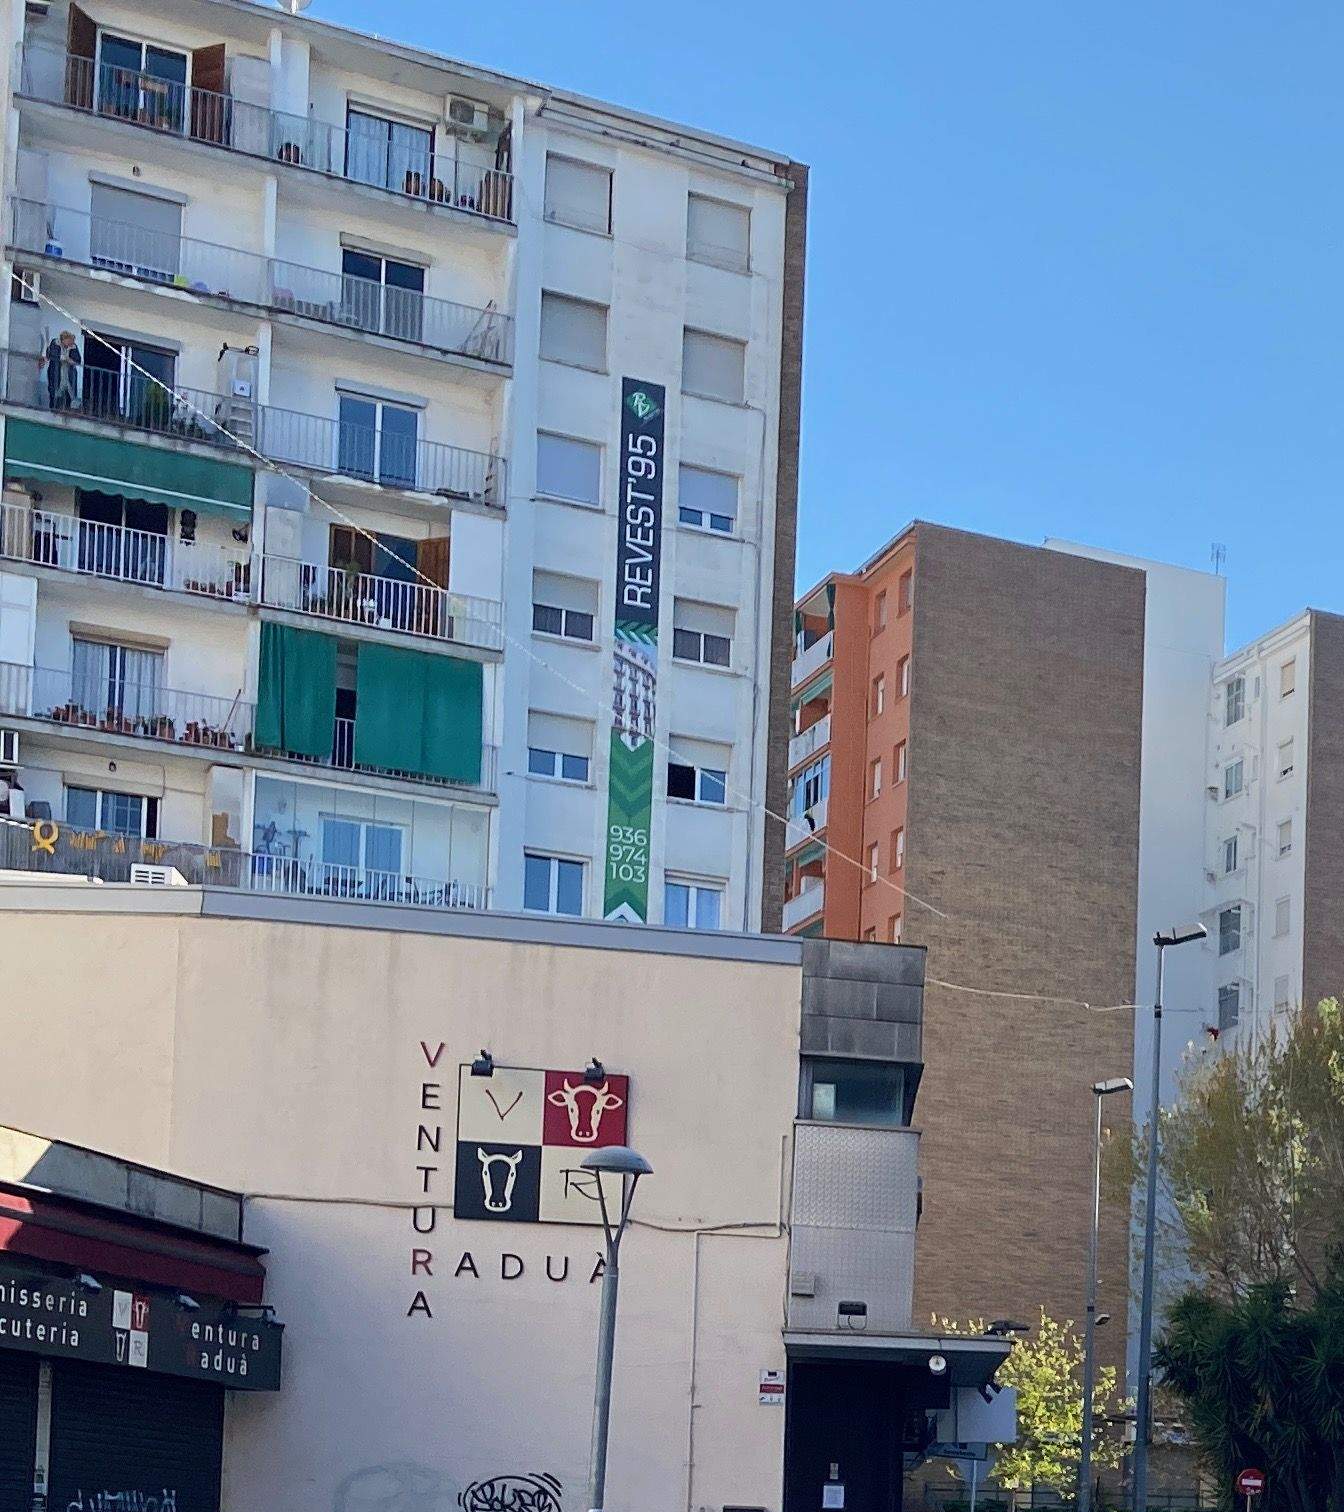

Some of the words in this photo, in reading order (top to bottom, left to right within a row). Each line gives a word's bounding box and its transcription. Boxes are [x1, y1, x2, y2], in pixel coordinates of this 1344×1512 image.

[624, 433, 657, 609] REVEST'95
[609, 825, 648, 845] 936
[609, 844, 648, 866] 974
[610, 862, 646, 884] 103
[406, 1040, 447, 1319] VENTURA
